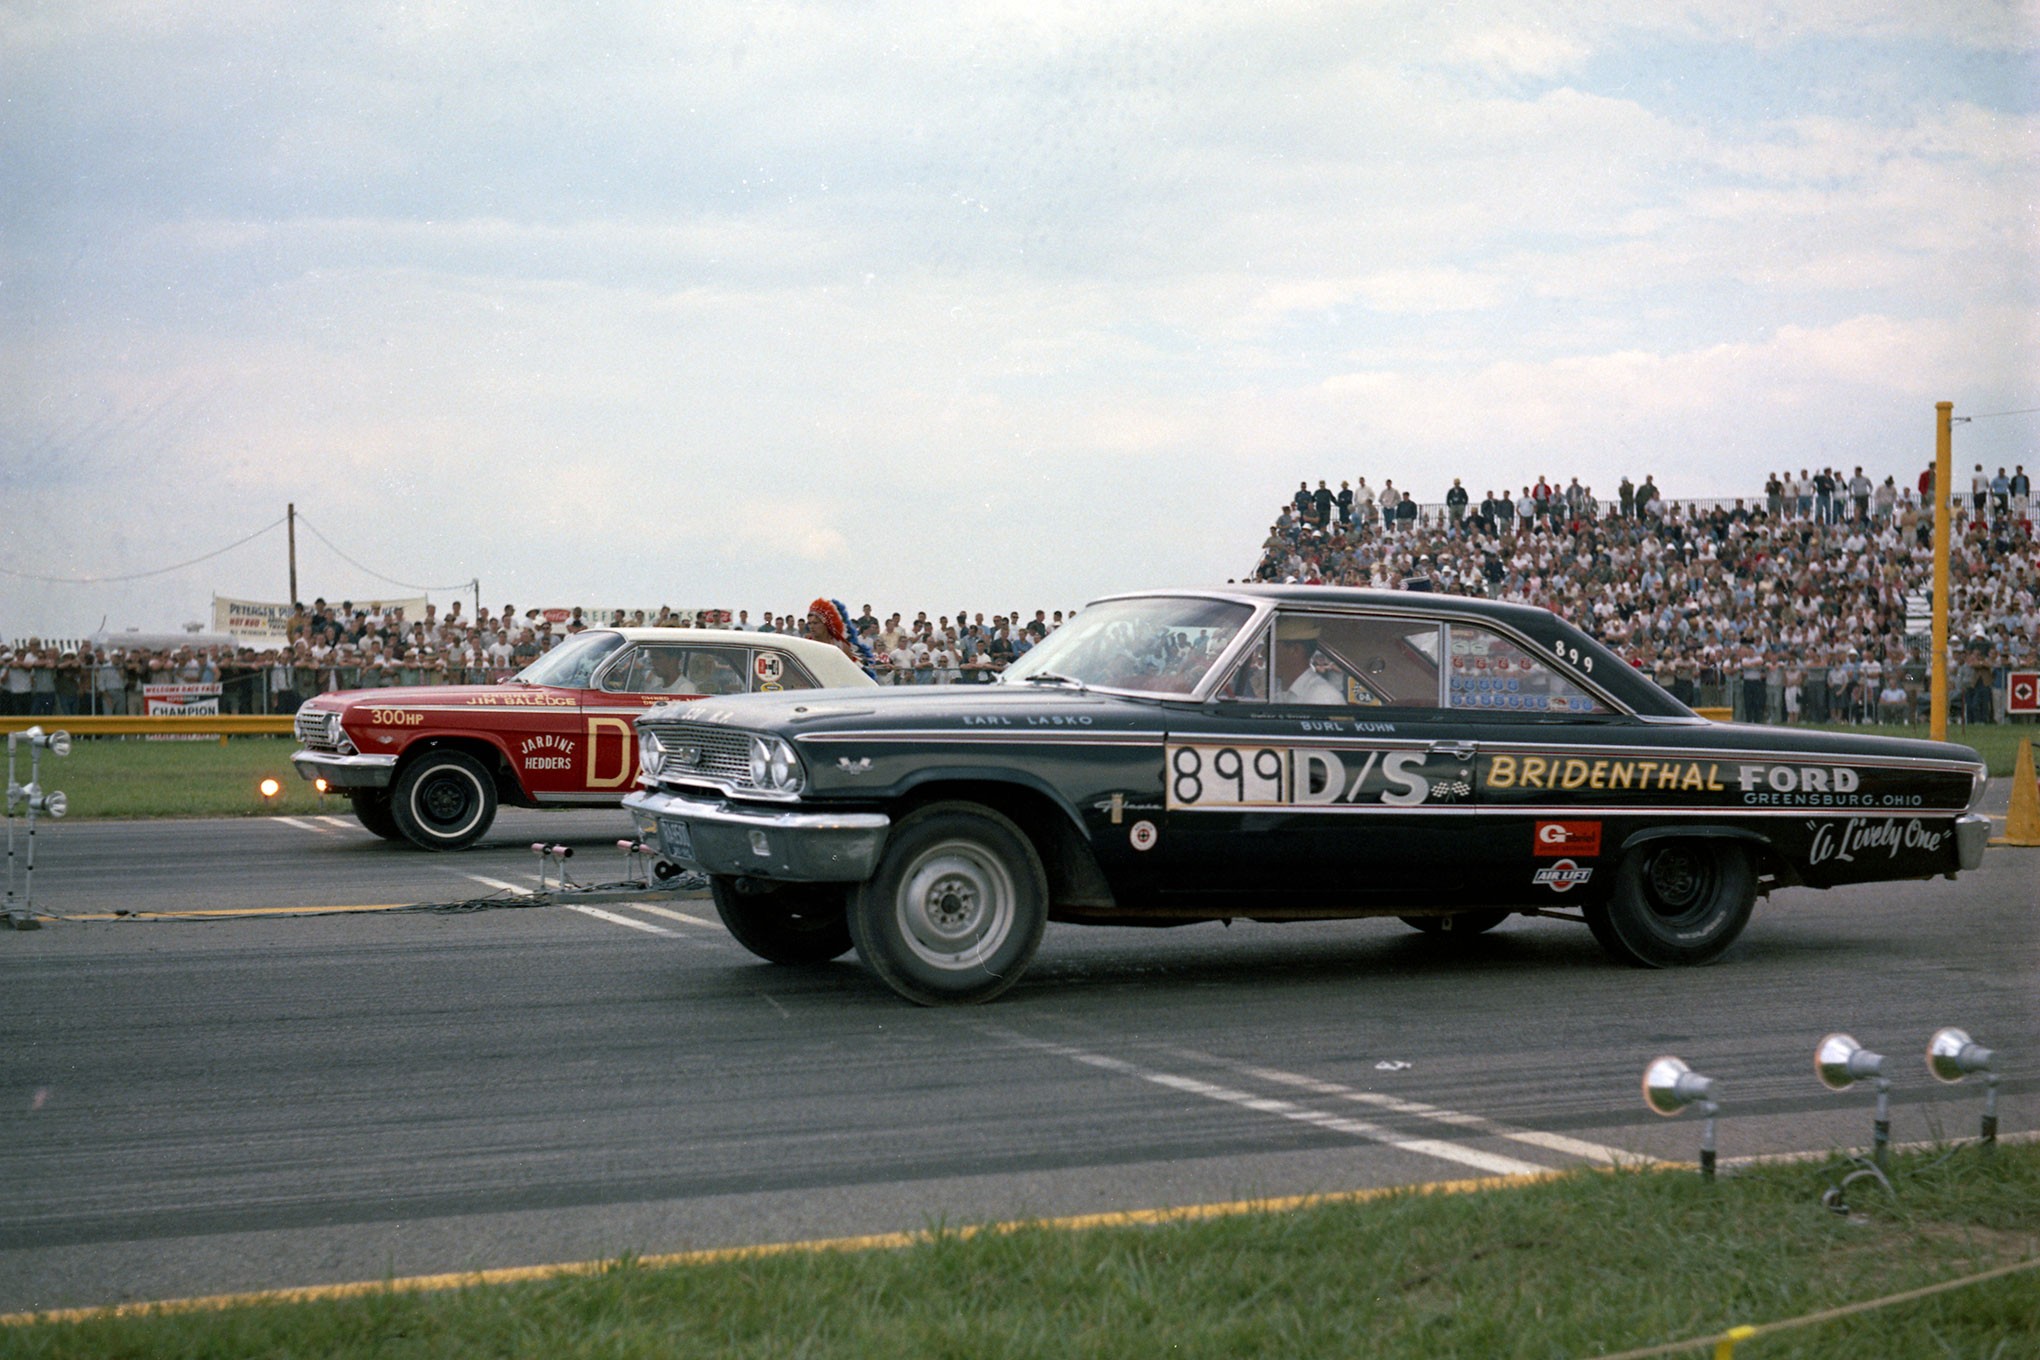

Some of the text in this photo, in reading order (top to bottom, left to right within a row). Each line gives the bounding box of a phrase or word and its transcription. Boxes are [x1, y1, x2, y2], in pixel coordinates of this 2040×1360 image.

[1555, 640, 1593, 673] 899
[466, 697, 497, 705] JIM
[152, 706, 216, 716] CHAMPION
[372, 710, 425, 725] 300HP
[962, 716, 1093, 725] EARL LASKO
[1300, 721, 1396, 732] BURL KUHN
[521, 734, 575, 755] JARDINE
[525, 757, 572, 770] HEDDERS
[1173, 746, 1282, 804] 899
[1292, 750, 1430, 806] D/S
[1487, 755, 1860, 793] BRIDENTHAL FORD
[1882, 794, 1922, 806] OHIO
[1835, 818, 1903, 862] Lively
[1538, 871, 1588, 880] AIR LIFT
